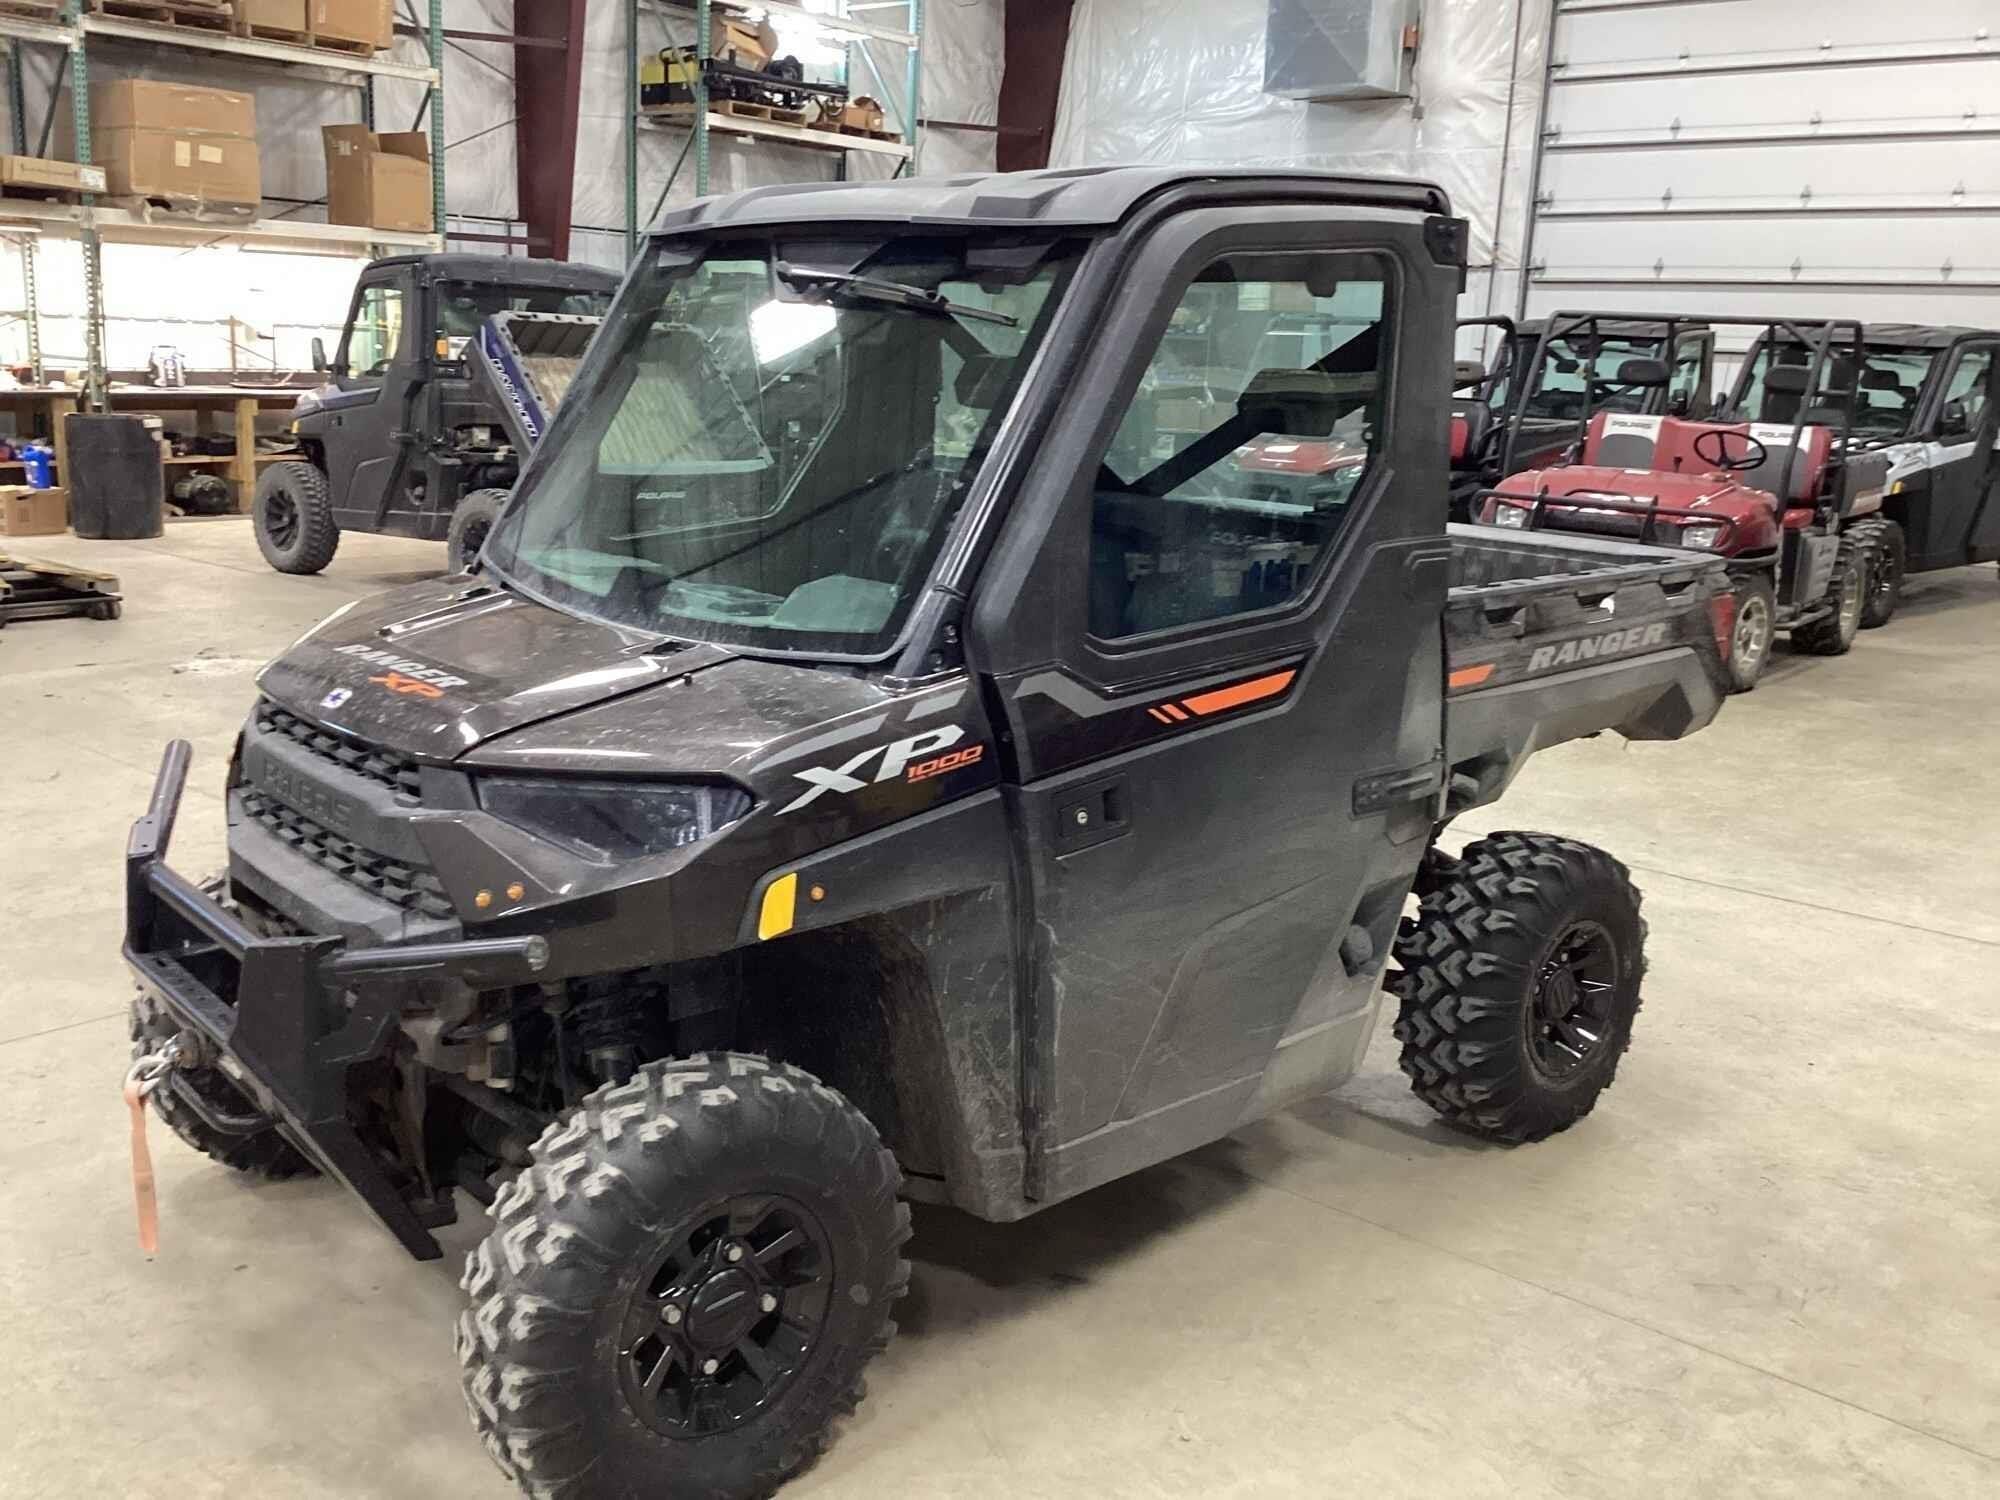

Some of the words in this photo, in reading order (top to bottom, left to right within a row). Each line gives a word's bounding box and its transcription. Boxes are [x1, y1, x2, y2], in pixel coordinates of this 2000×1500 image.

[488, 358, 540, 437] RANGER
[333, 644, 469, 688] RANGER
[1527, 622, 1669, 672] RANGER
[367, 671, 446, 698] XP
[774, 724, 965, 816] XP
[907, 745, 984, 778] 1000
